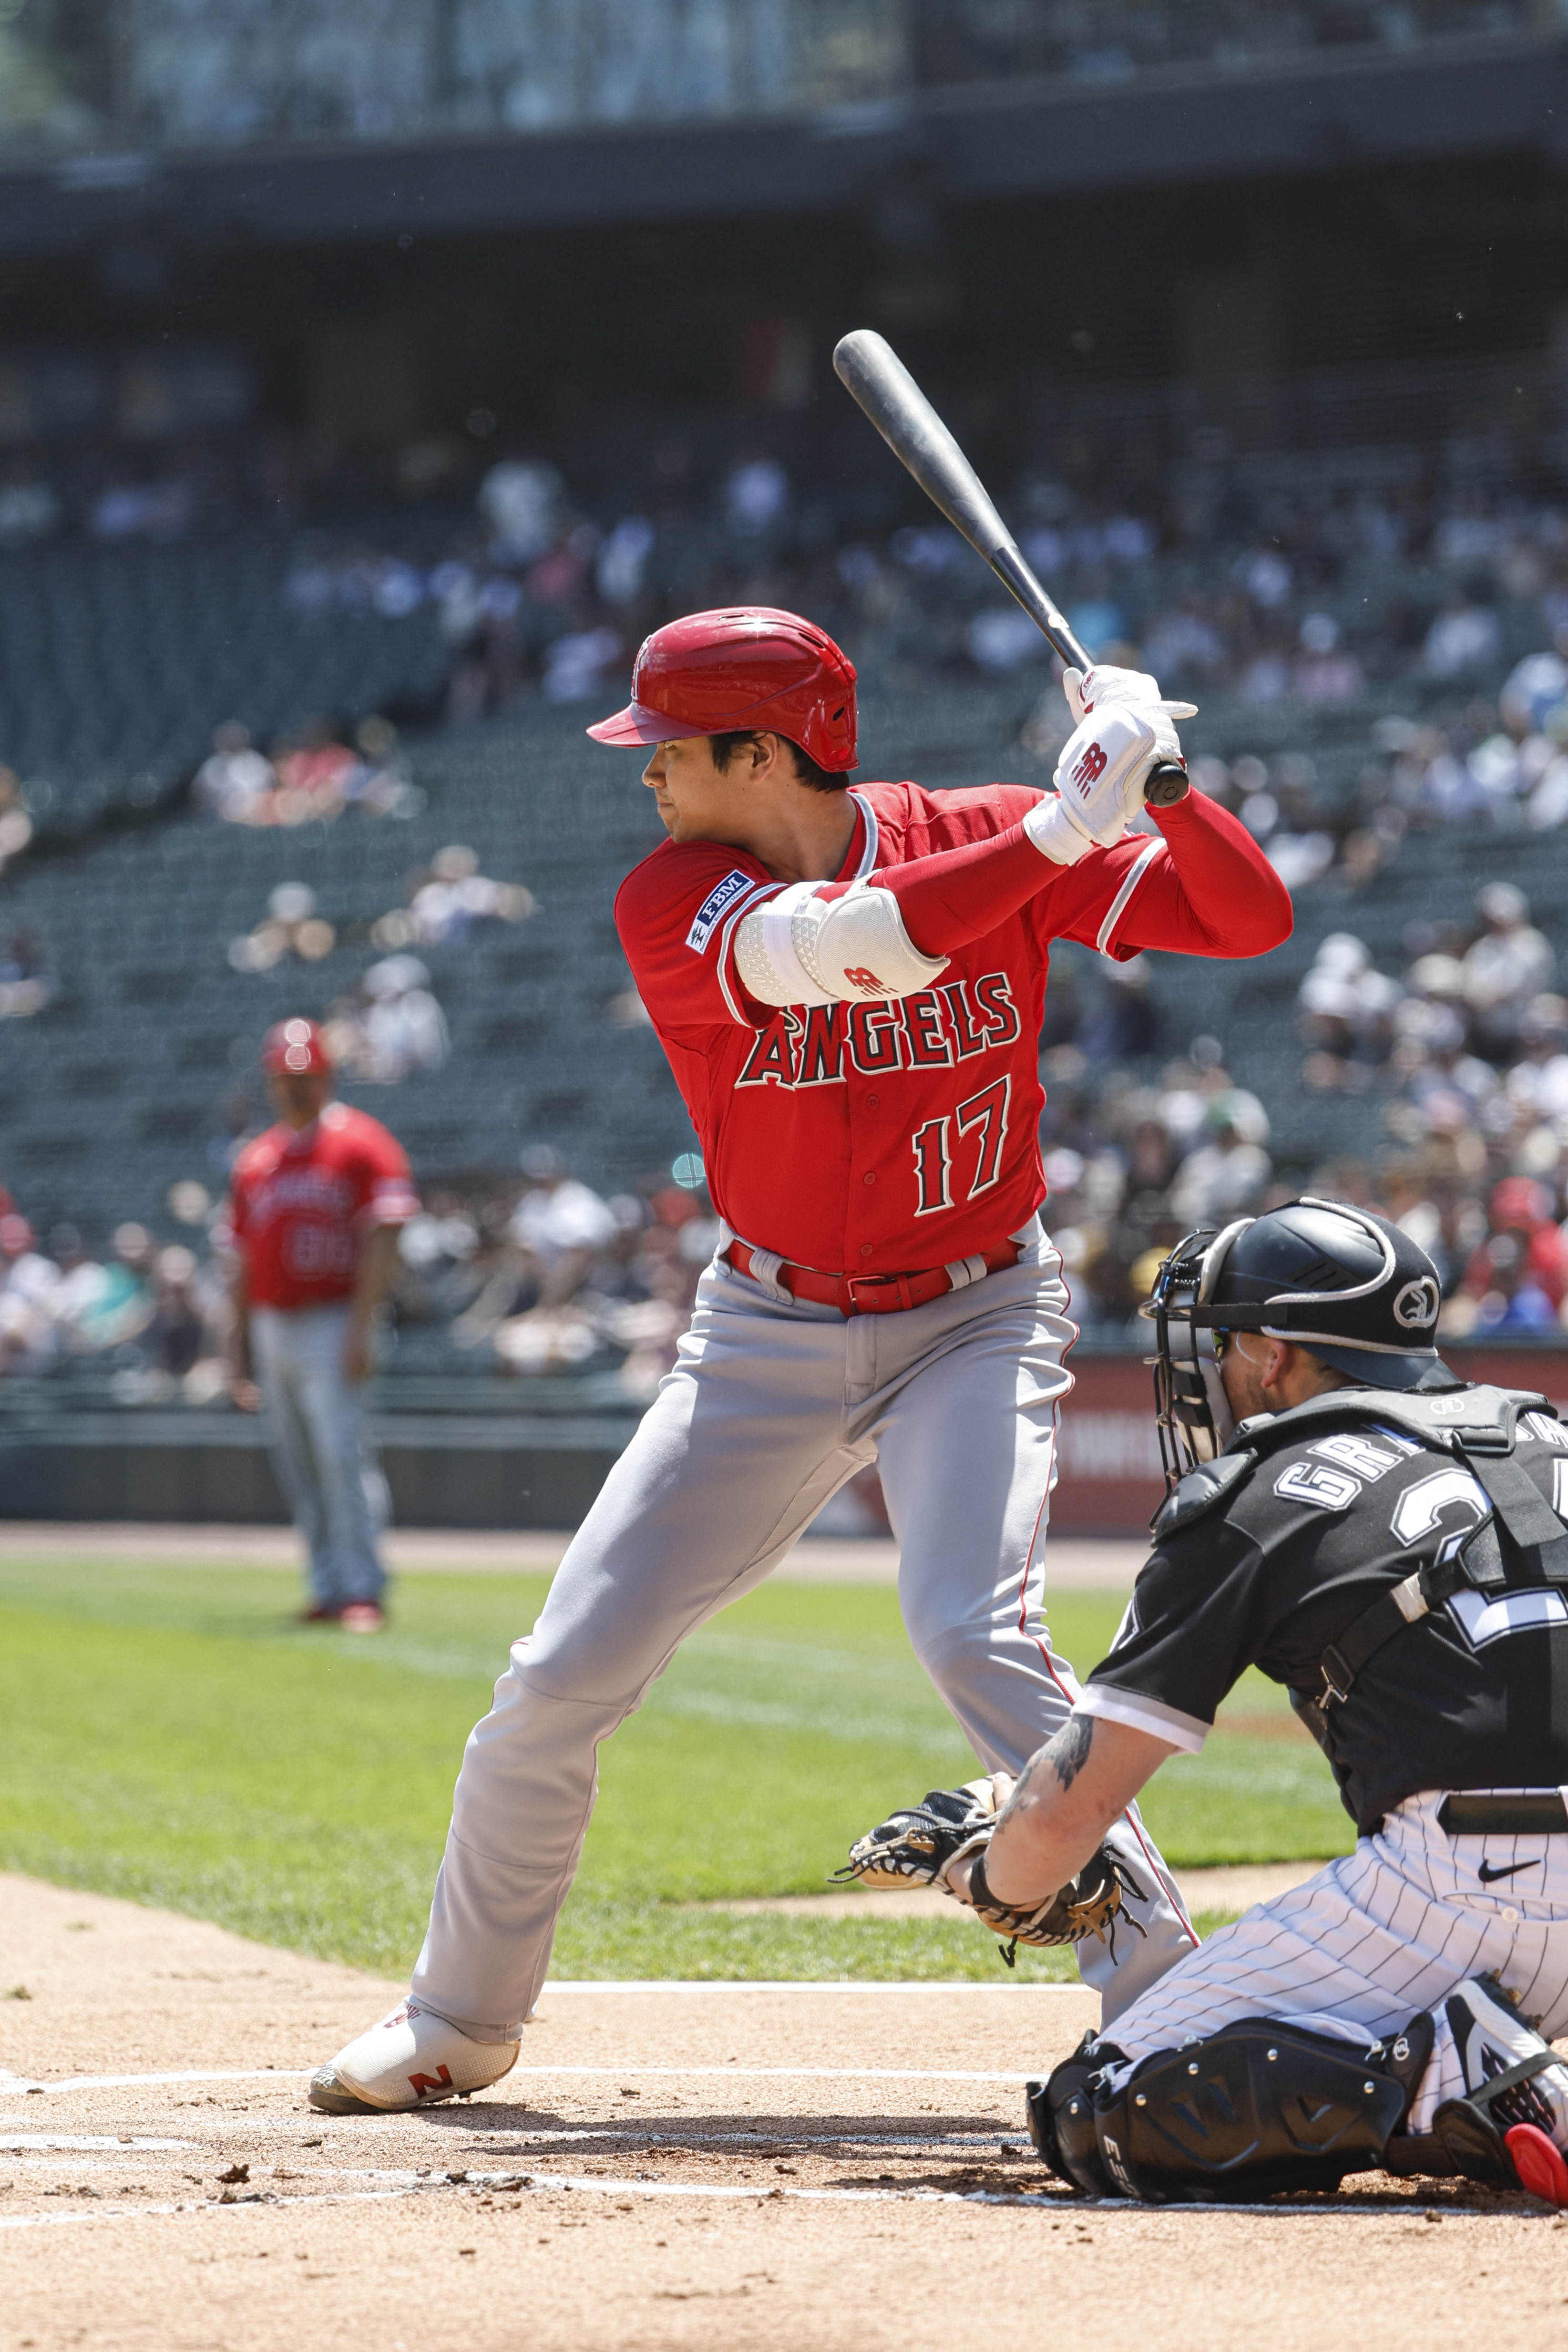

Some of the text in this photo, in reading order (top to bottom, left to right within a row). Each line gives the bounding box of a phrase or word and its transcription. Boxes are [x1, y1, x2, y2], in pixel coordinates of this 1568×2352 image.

[699, 882, 754, 952] Foundation Building Materials
[702, 876, 743, 919] FBM
[734, 971, 1022, 1091] ANGELS
[912, 1073, 1011, 1217] 17
